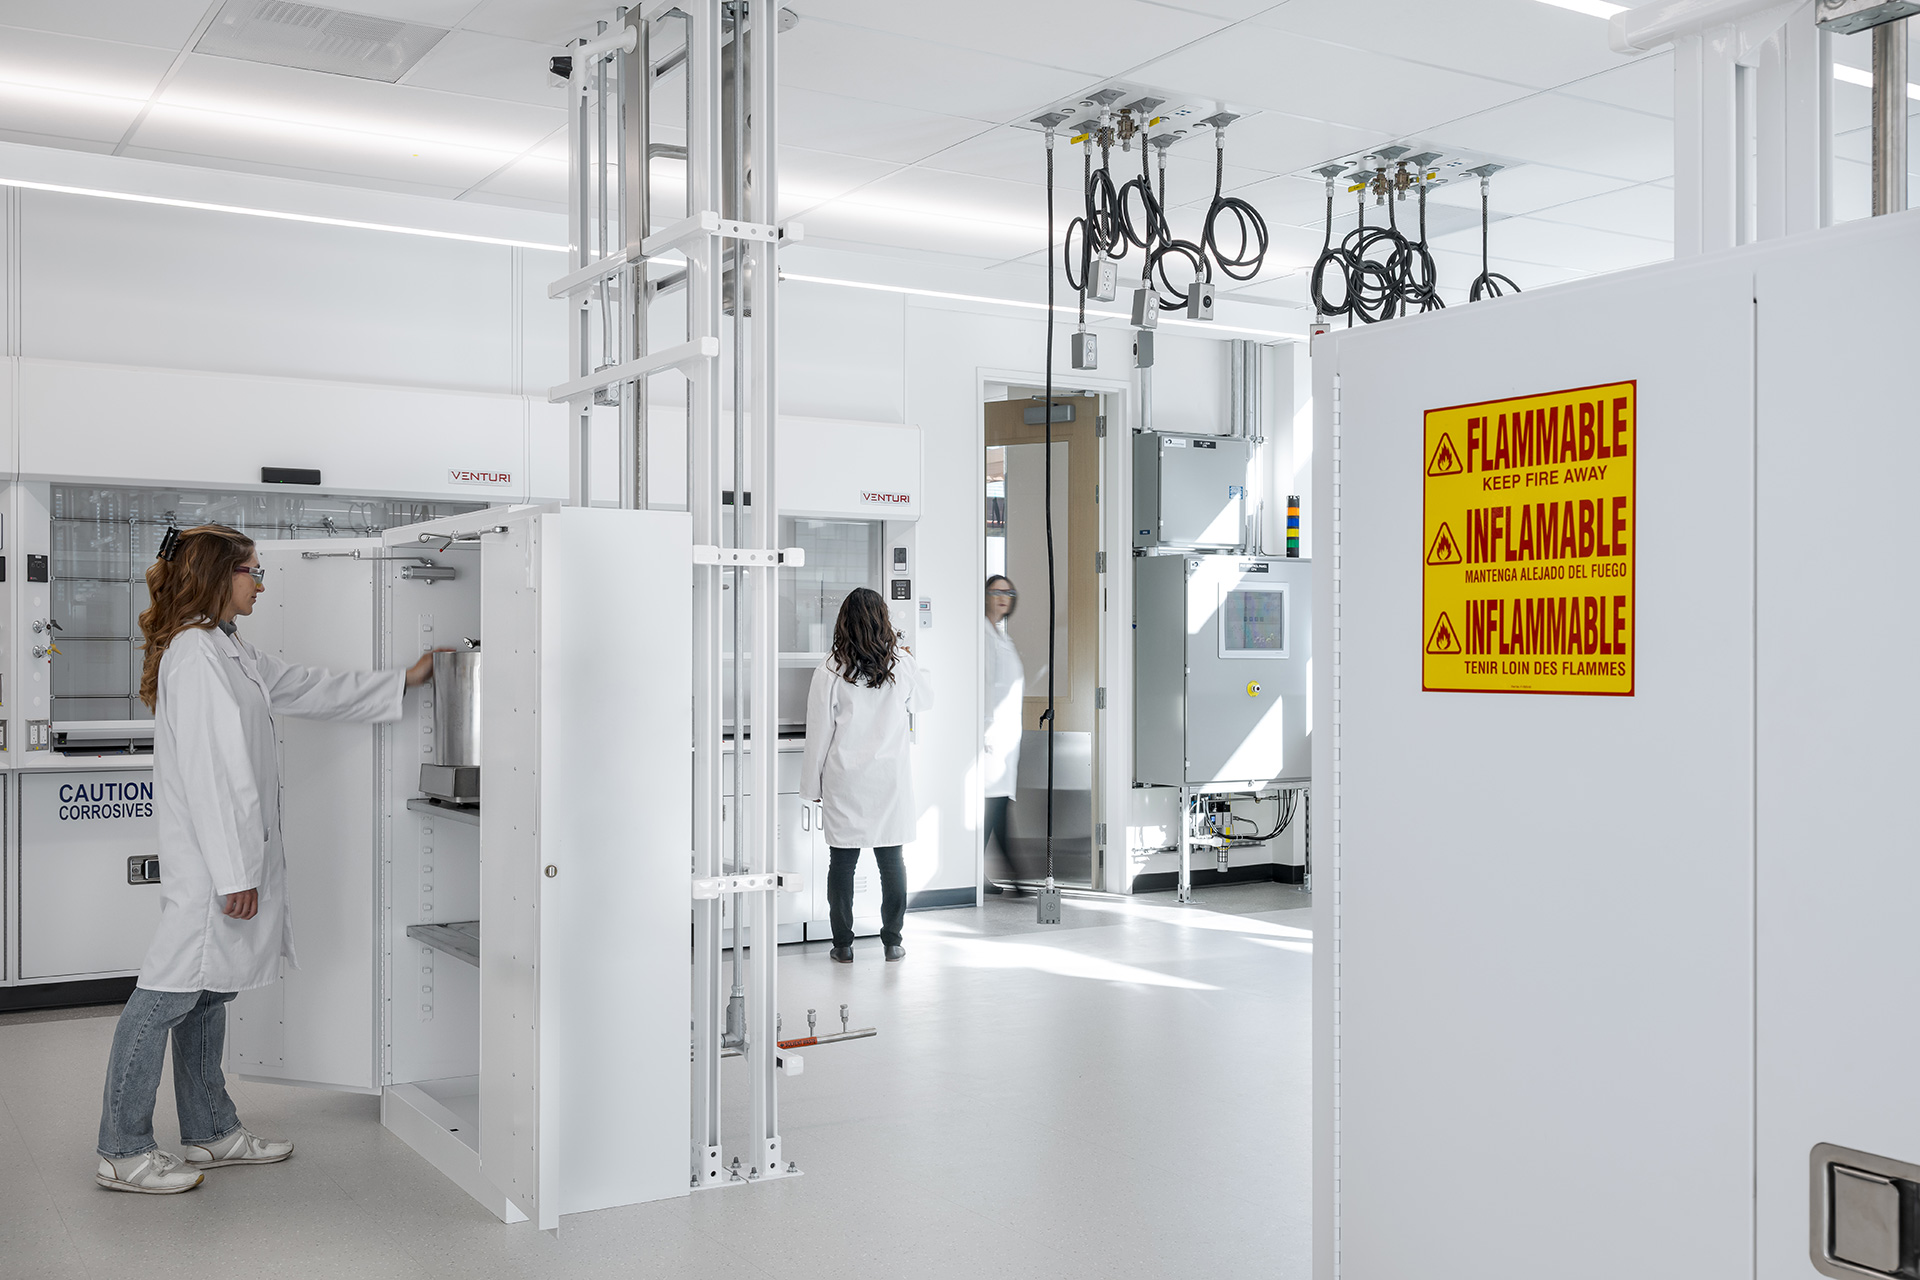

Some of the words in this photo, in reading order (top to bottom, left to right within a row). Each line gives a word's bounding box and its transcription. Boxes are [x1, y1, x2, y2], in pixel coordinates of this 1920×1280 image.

[1466, 396, 1628, 474] FLAMMABLE
[450, 470, 511, 482] VENTURI
[1482, 476, 1521, 491] KEEP
[1525, 471, 1560, 487] FIRE
[1563, 465, 1608, 483] AWAY
[862, 492, 910, 503] VENTURI
[1465, 496, 1627, 565] INFLAMABLE
[1465, 568, 1518, 583] MANTENGA
[1520, 566, 1565, 581] ALEJADO
[1568, 565, 1588, 579] DEL
[1591, 563, 1627, 578] FUEGO
[1465, 595, 1626, 656] INFLAMMABLE
[1464, 661, 1498, 675] TENIR
[1502, 661, 1530, 675] LOIN
[1533, 661, 1558, 676] DES
[1562, 661, 1626, 676] FLAMMES
[59, 782, 153, 803] CAUTION
[59, 802, 153, 820] CORROSIVES
